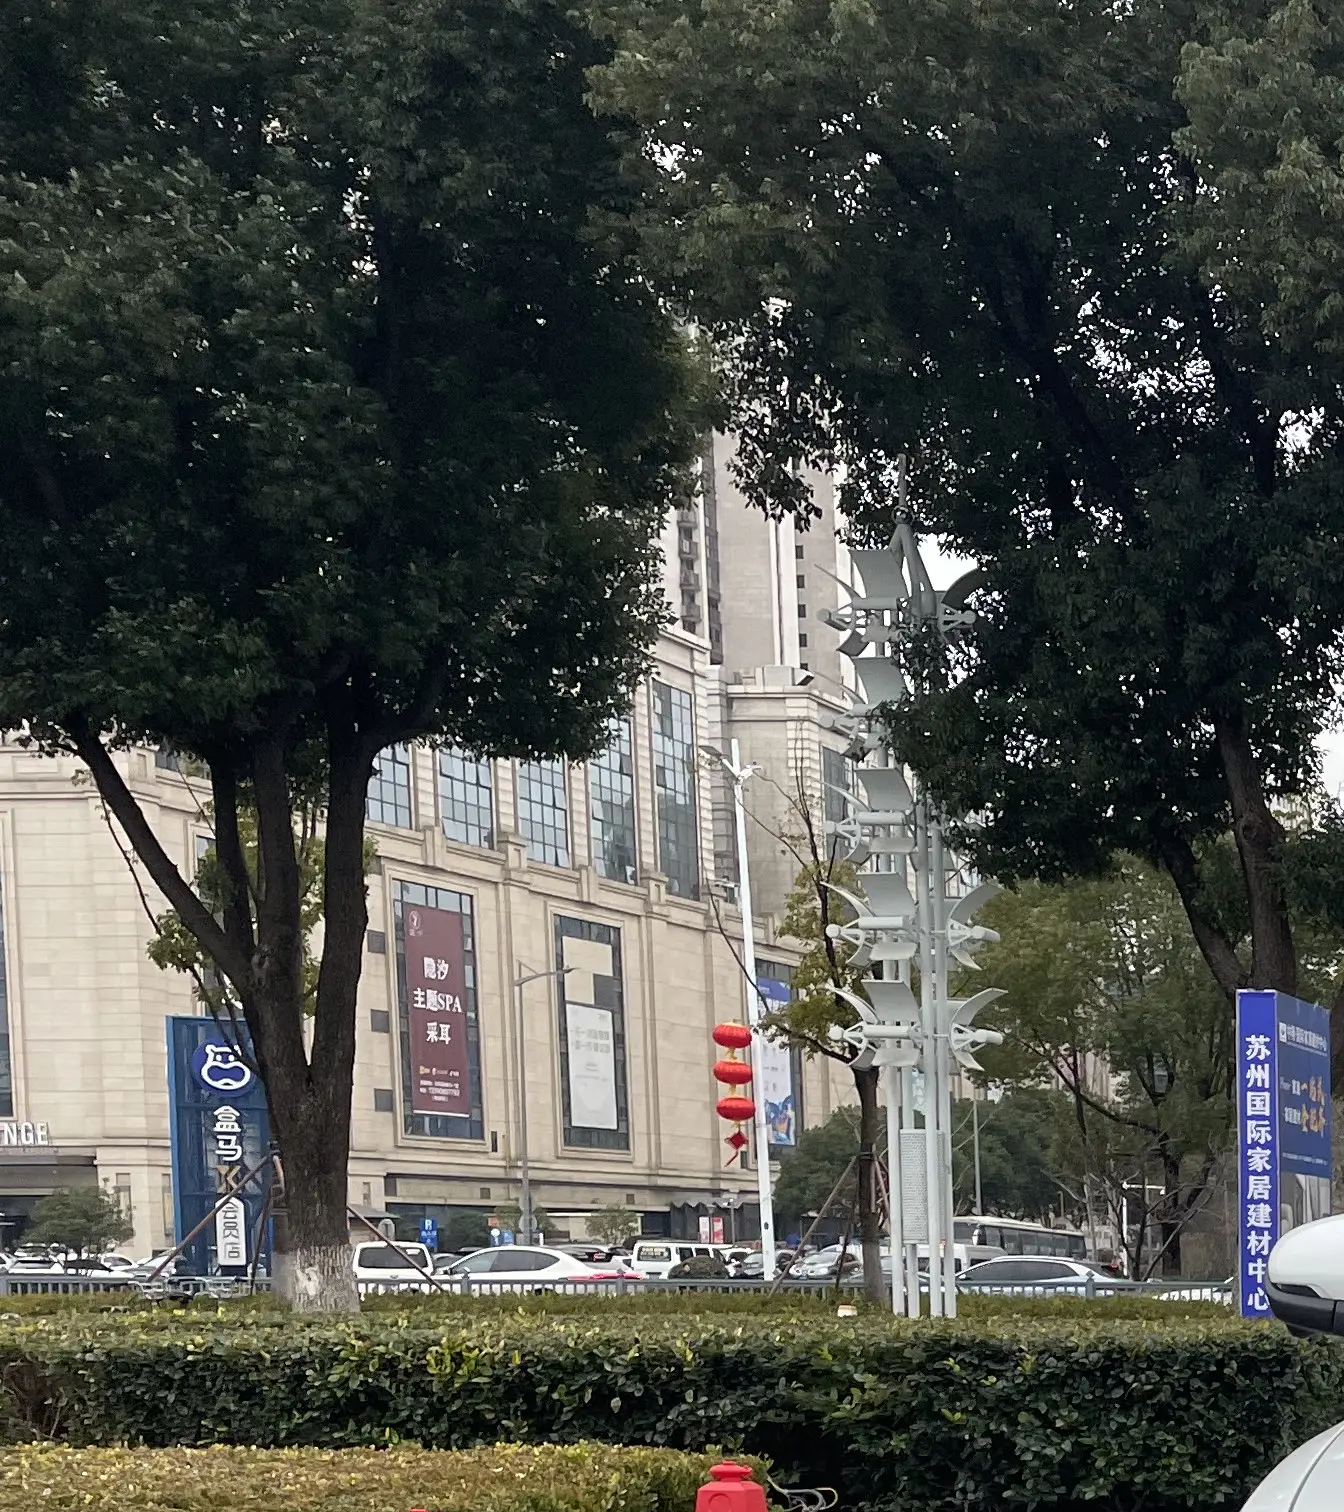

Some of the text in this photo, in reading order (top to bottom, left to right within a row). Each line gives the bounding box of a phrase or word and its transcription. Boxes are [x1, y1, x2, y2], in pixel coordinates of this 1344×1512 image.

[413, 988, 463, 1013] 主题SPA
[426, 1022, 451, 1044] 采耳
[213, 1105, 242, 1162] 盒马
[1246, 1035, 1272, 1311] 苏州国际家居建材中心
